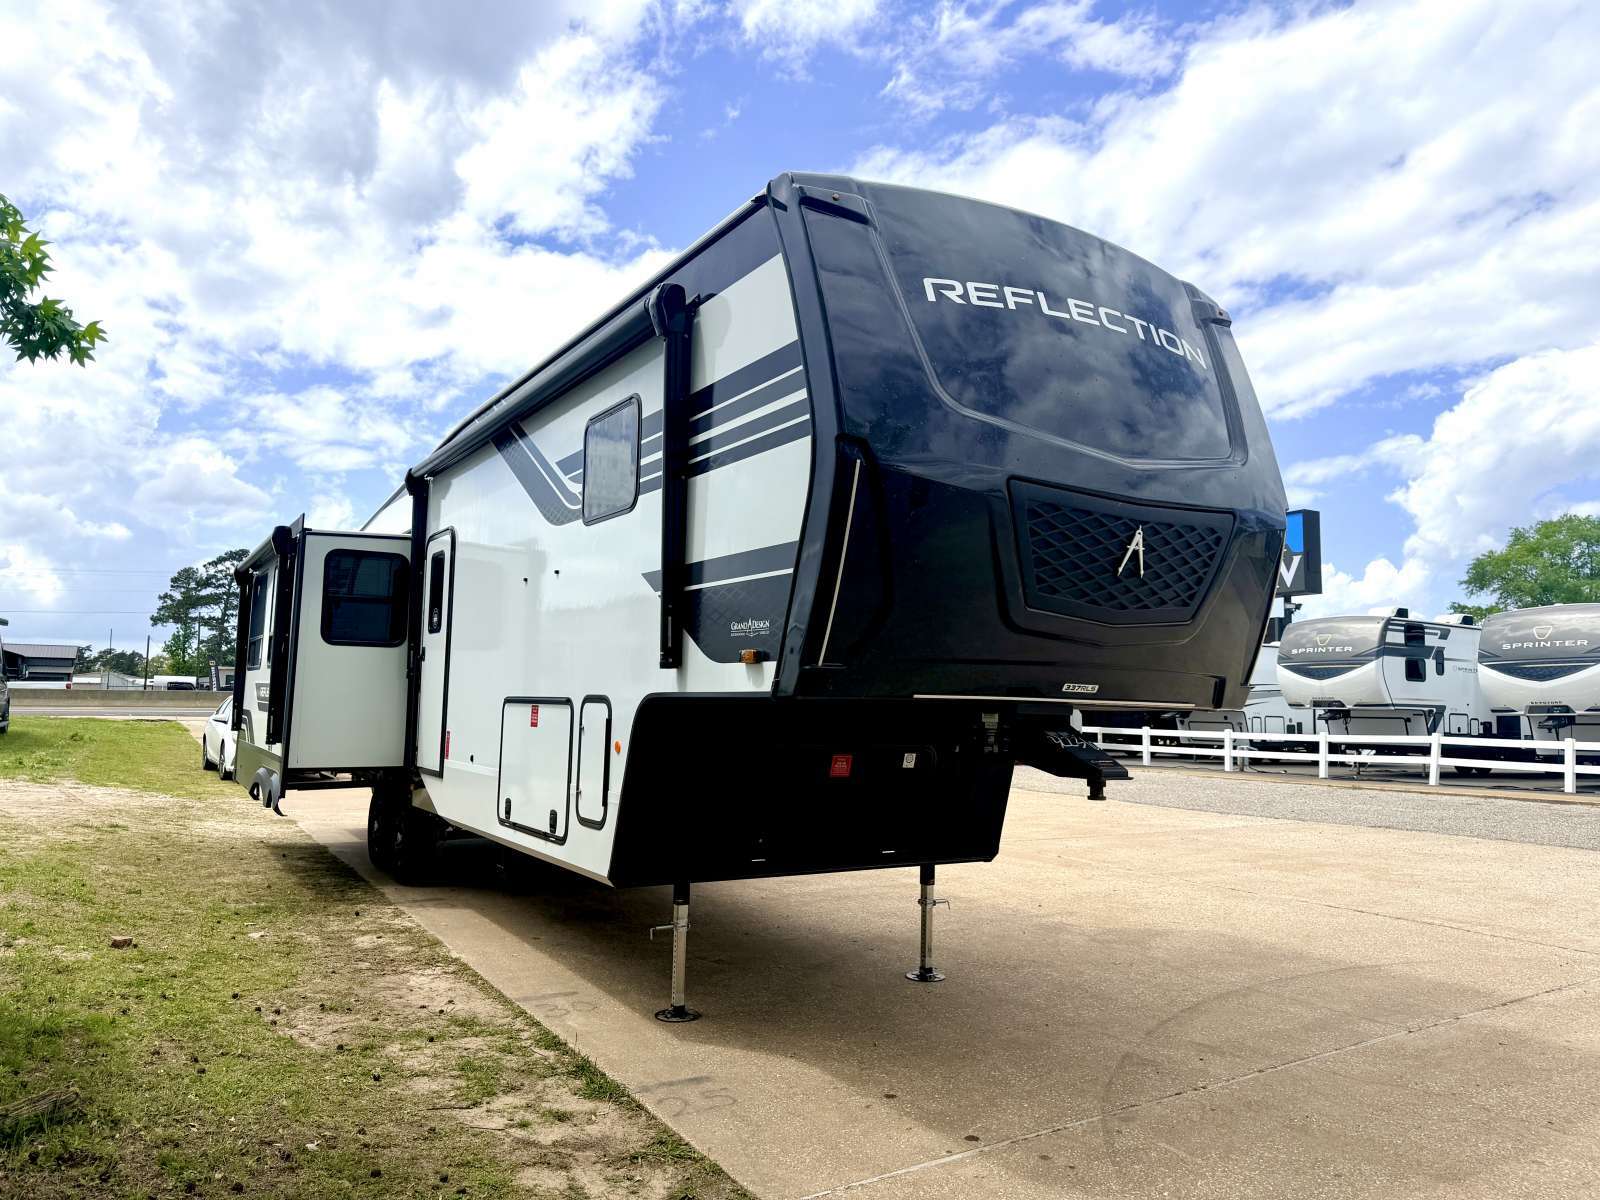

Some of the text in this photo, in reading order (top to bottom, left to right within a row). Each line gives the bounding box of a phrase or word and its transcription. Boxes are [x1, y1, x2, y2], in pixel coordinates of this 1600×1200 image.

[923, 277, 1207, 369] REFLECTION
[1502, 640, 1589, 650] SPRINTER
[1291, 646, 1353, 655] SPRINTER
